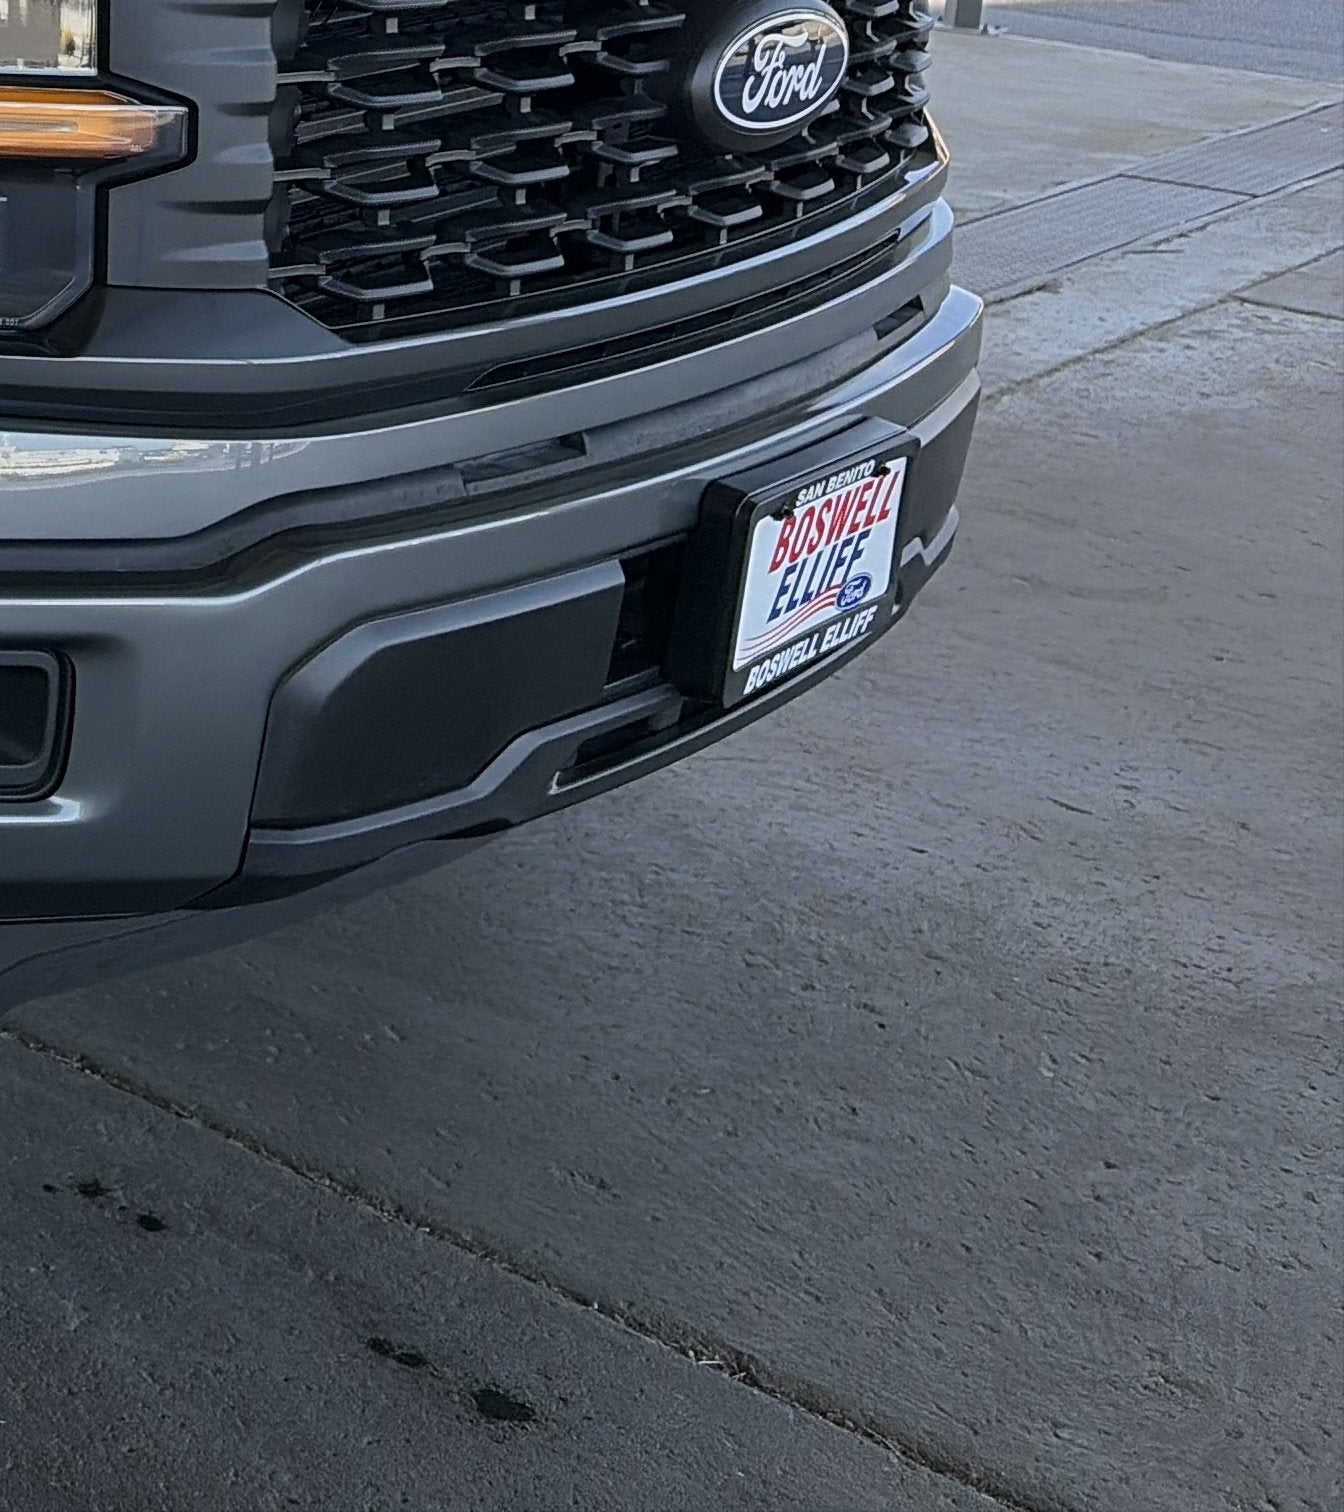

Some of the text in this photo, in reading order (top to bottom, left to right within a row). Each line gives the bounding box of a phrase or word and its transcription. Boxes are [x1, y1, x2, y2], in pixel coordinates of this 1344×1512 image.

[742, 31, 826, 114] Ford
[768, 471, 900, 575] BOSWELL
[796, 459, 876, 506] SAN BENITO
[767, 529, 872, 624] ELLIFF
[743, 605, 878, 695] BOSWELL ELLIFF
